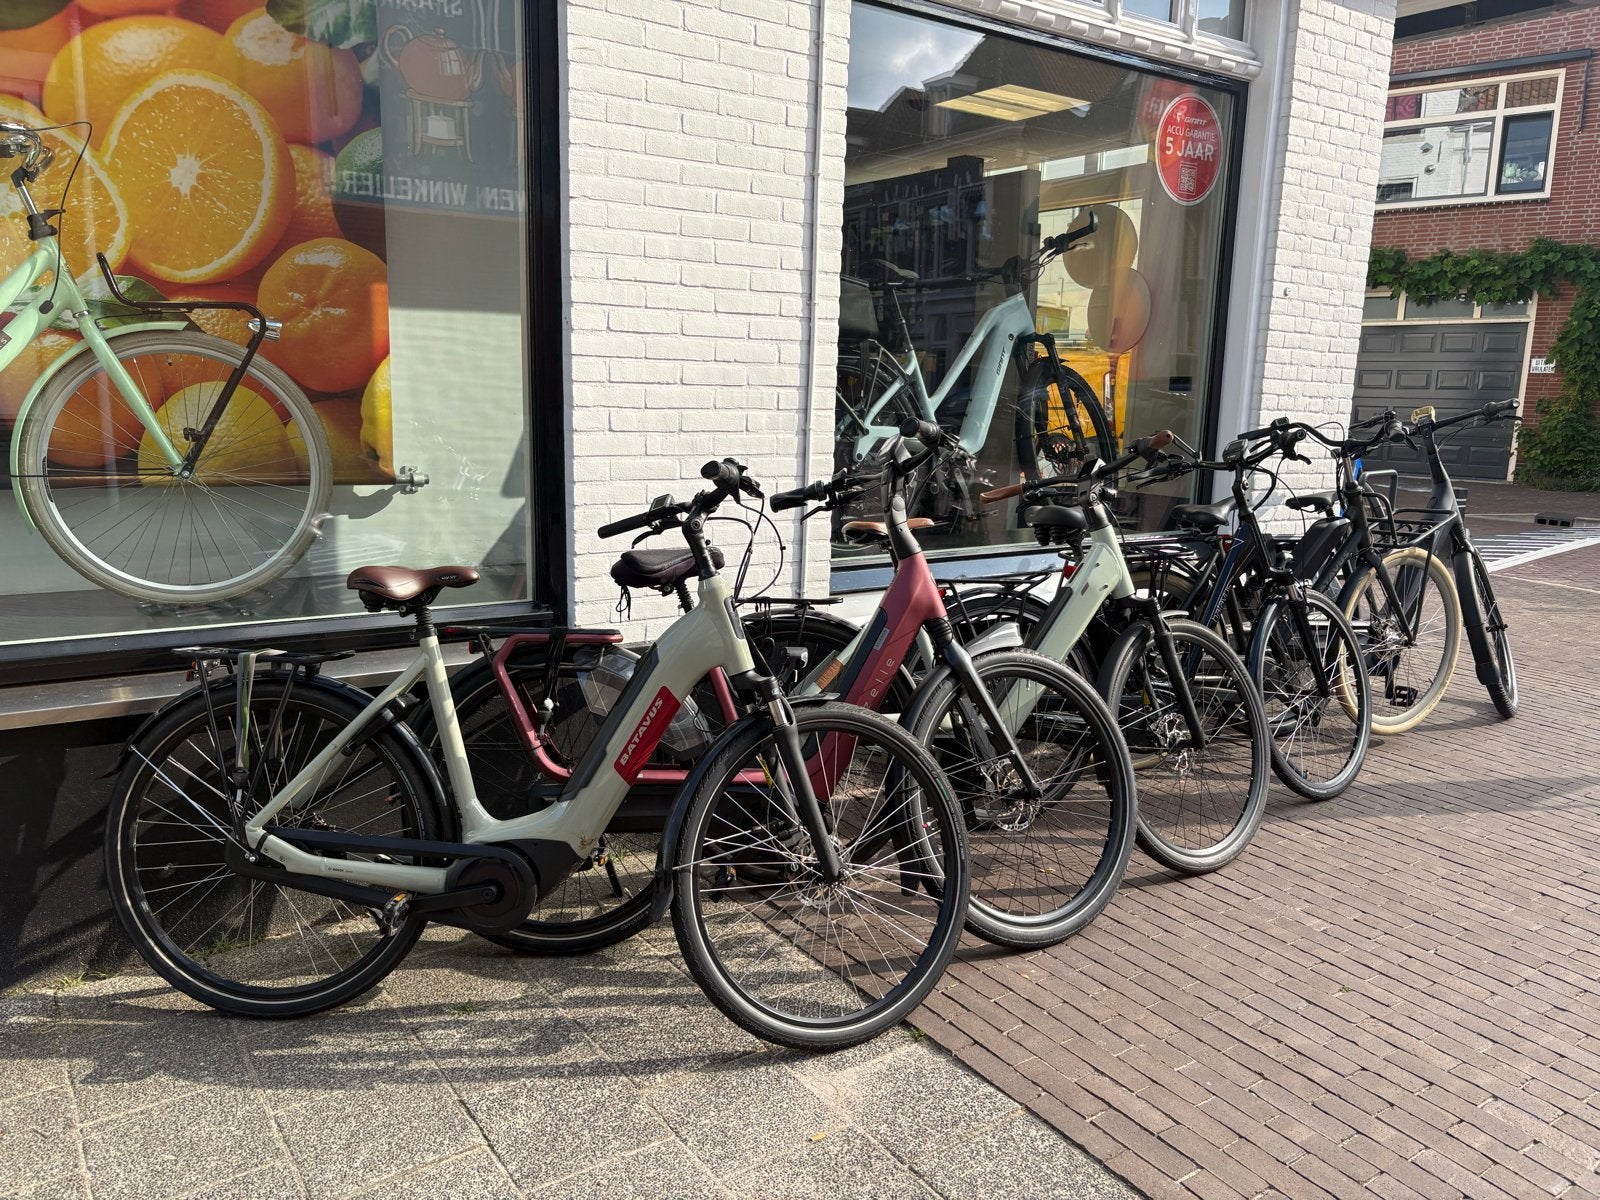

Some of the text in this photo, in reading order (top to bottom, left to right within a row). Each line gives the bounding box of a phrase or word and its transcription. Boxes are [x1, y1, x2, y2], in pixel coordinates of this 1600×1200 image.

[1165, 136, 1214, 162] 5 JAAR
[1166, 124, 1215, 141] ACCU GARANTIE
[863, 658, 895, 709] zelle
[620, 697, 663, 766] BATAVUS
